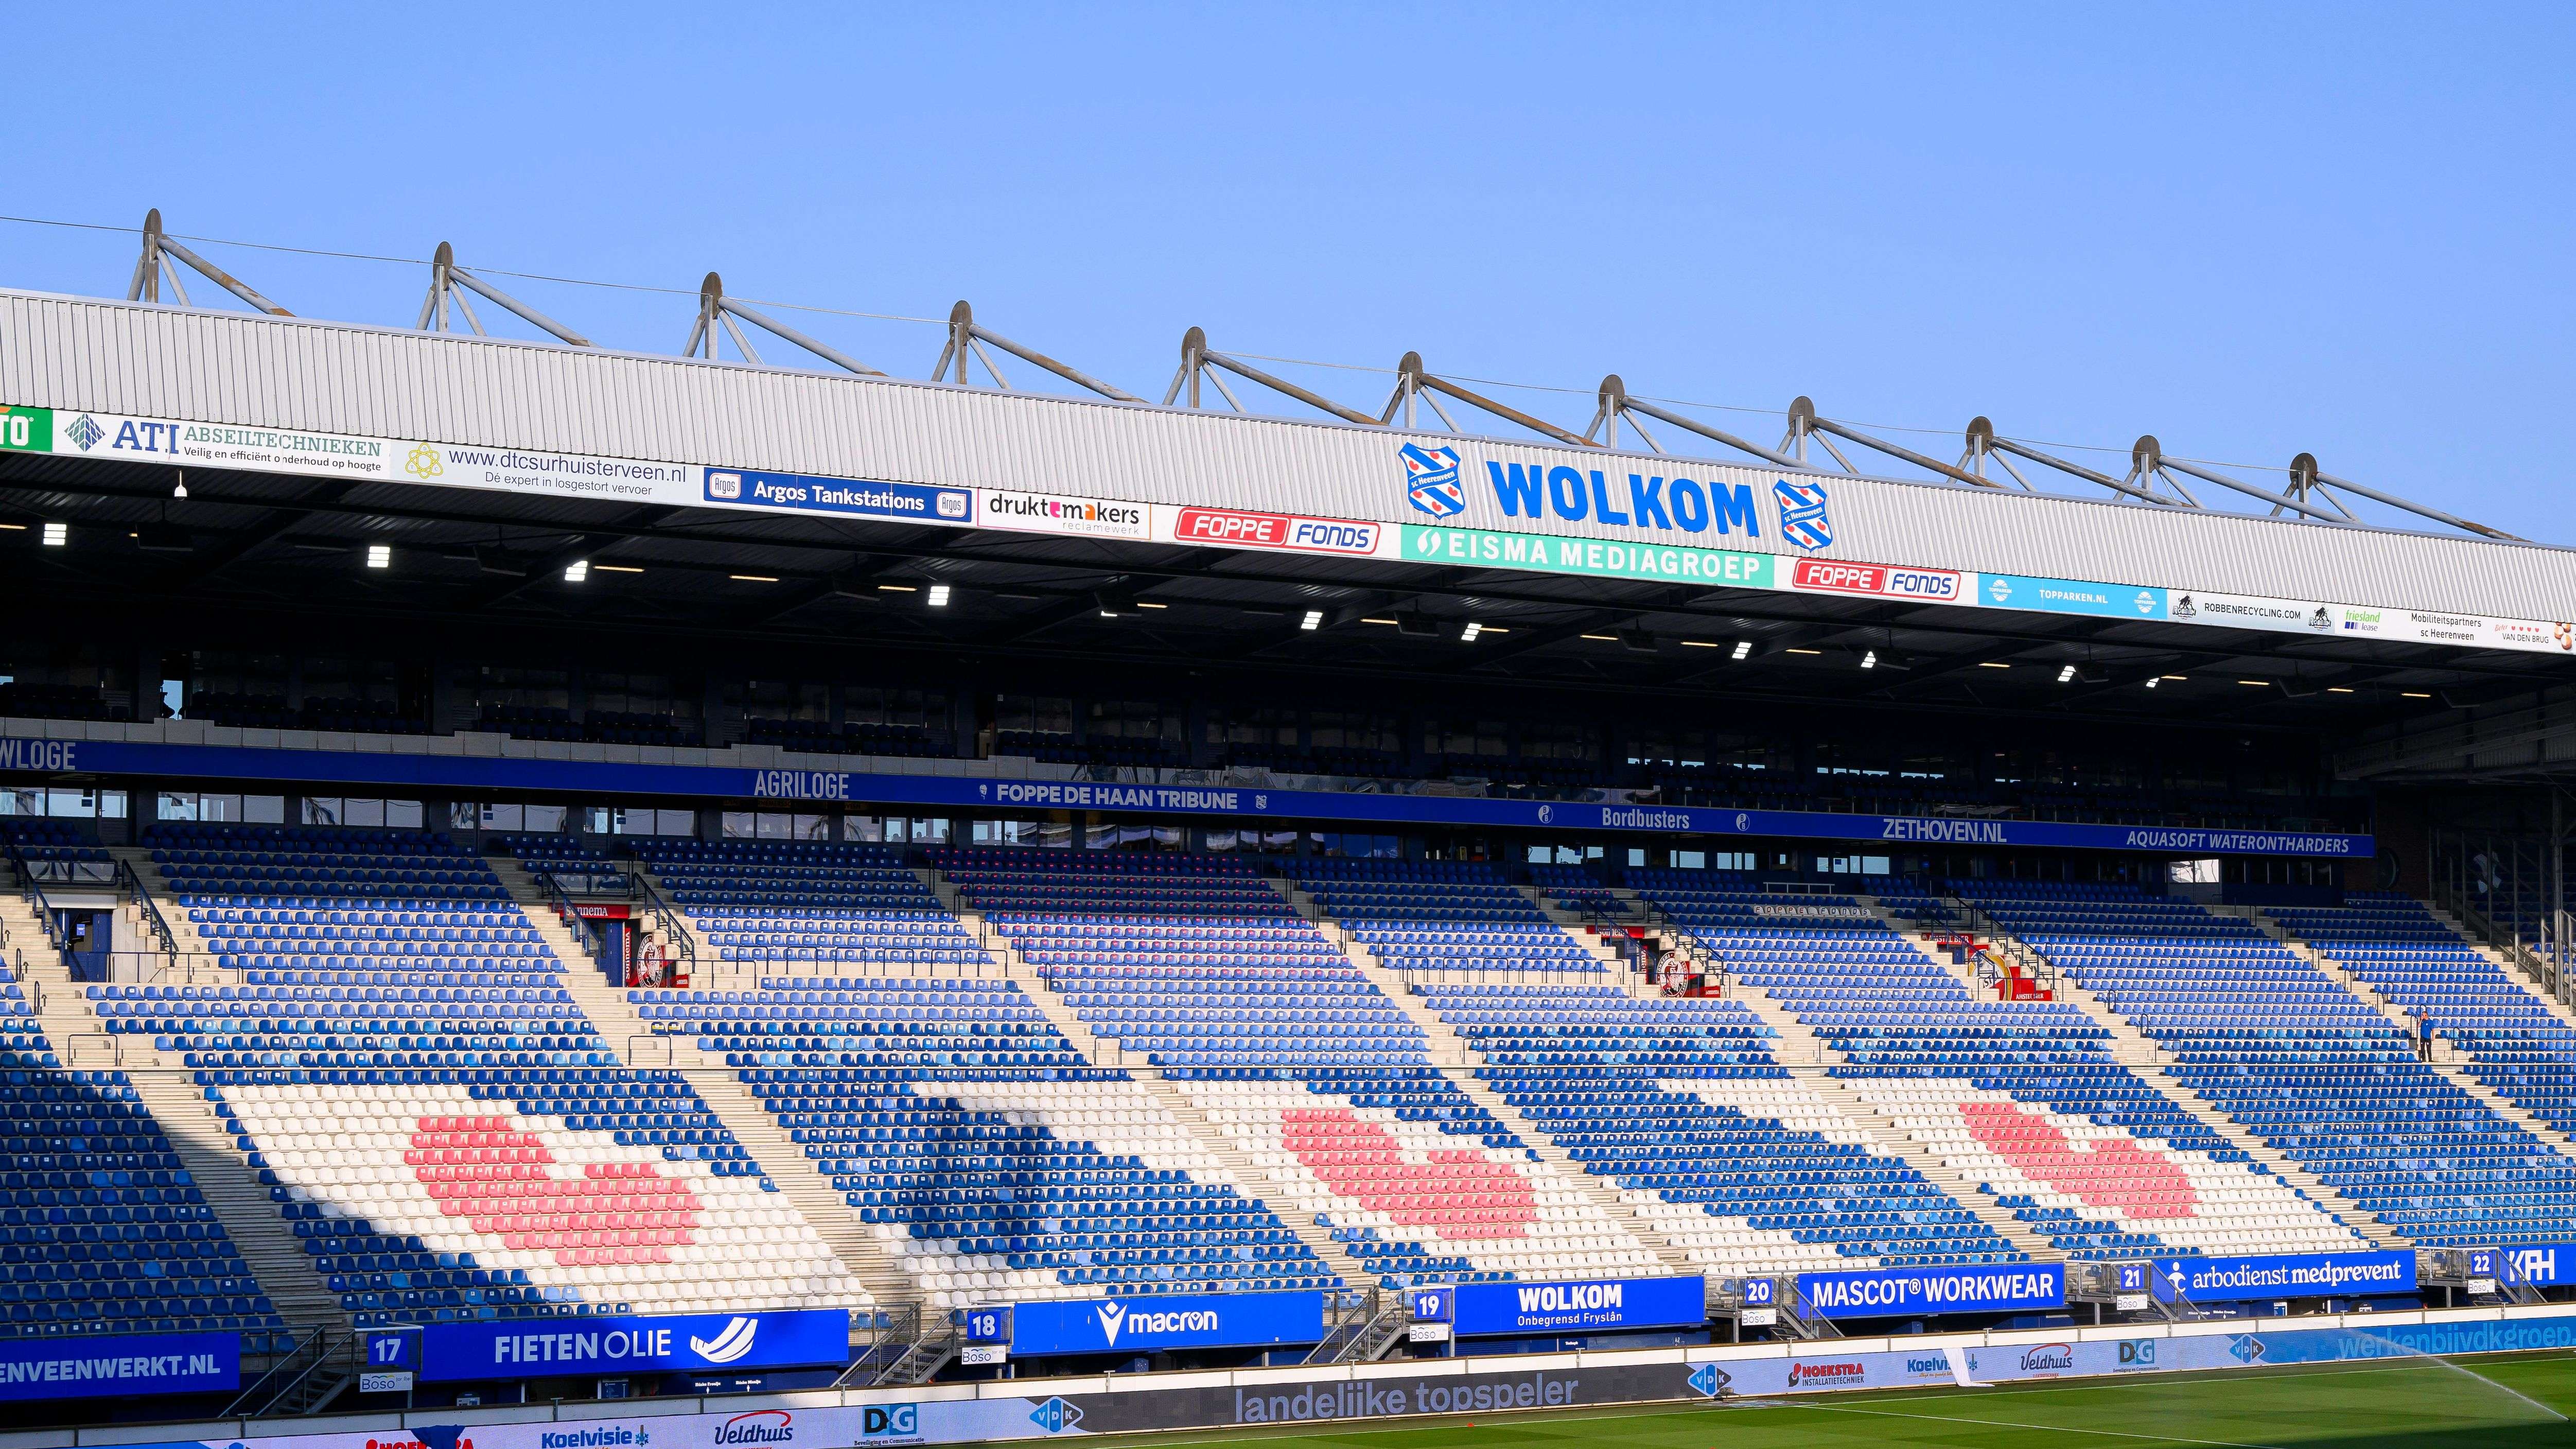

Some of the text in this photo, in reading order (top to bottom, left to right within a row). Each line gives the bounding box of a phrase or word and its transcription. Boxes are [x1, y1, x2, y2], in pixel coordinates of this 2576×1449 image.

[112, 421, 381, 457] ATI ABSEILTECHNIEKEN
[184, 447, 381, 472] Veilig en efficiënt onderhoud op hoogte
[449, 450, 686, 482] www.dtcsurhuisterveen.nl
[485, 472, 652, 495] Dé expert in losgestort vervoer
[715, 478, 735, 494] Argos
[1418, 471, 1455, 485] Heerenveen
[754, 481, 925, 511] Argos Tankstations
[942, 496, 961, 513] Argos
[1486, 460, 1759, 537] WOLKOM
[1790, 507, 1823, 519] Heerenveen
[1063, 521, 1138, 535] reclamewerk
[1193, 515, 1369, 548] FOPPE FONDS
[1448, 533, 1760, 580] EISMA MEDIAGROEP
[1807, 566, 1952, 595] FOPPE FONDS
[2039, 589, 2108, 604] TOPPARKEN.NL
[2204, 603, 2301, 619] ROBBENRECYCLING.COM
[2346, 609, 2380, 622] friesland
[2411, 613, 2481, 627] Mobiliteitspartners
[2431, 629, 2474, 640] Heerenveen
[754, 771, 849, 799] AGRILOGE
[997, 784, 1237, 809] FOPPE DE HAAN TRIBUNE
[1603, 808, 1689, 829] Bordbusters
[1883, 818, 2007, 842] ZETHOVEN.NL
[2127, 831, 2349, 852] AQUASOFT WATERONTHARDERS
[2193, 1260, 2401, 1288] arbodienst medprevent
[2474, 1255, 2490, 1272] 22
[2125, 1269, 2140, 1287] 21
[1518, 1284, 1622, 1312] WOLKOM
[1748, 1282, 1769, 1301] 20
[1420, 1295, 1439, 1316] 19
[973, 1315, 995, 1336] 18
[1129, 1311, 1218, 1334] macron
[1518, 1311, 1622, 1327] Onbegrensd Fryslân
[376, 1339, 401, 1361] 17
[495, 1329, 671, 1363] FIETEN OLIE
[2235, 1344, 2258, 1355] VDK
[1802, 1363, 1864, 1377] HOEKSTRA
[2021, 1353, 2072, 1371] Veldhuis
[362, 1379, 395, 1390] Boso
[1696, 1373, 1725, 1386] VDK
[1802, 1375, 1864, 1386] INSTALLATIETECHNIEK
[1235, 1373, 1579, 1424] landelijke topspeler
[1037, 1408, 1074, 1421] VDK
[542, 1426, 632, 1448] Koelvisie
[715, 1422, 793, 1445] Veldhuis
